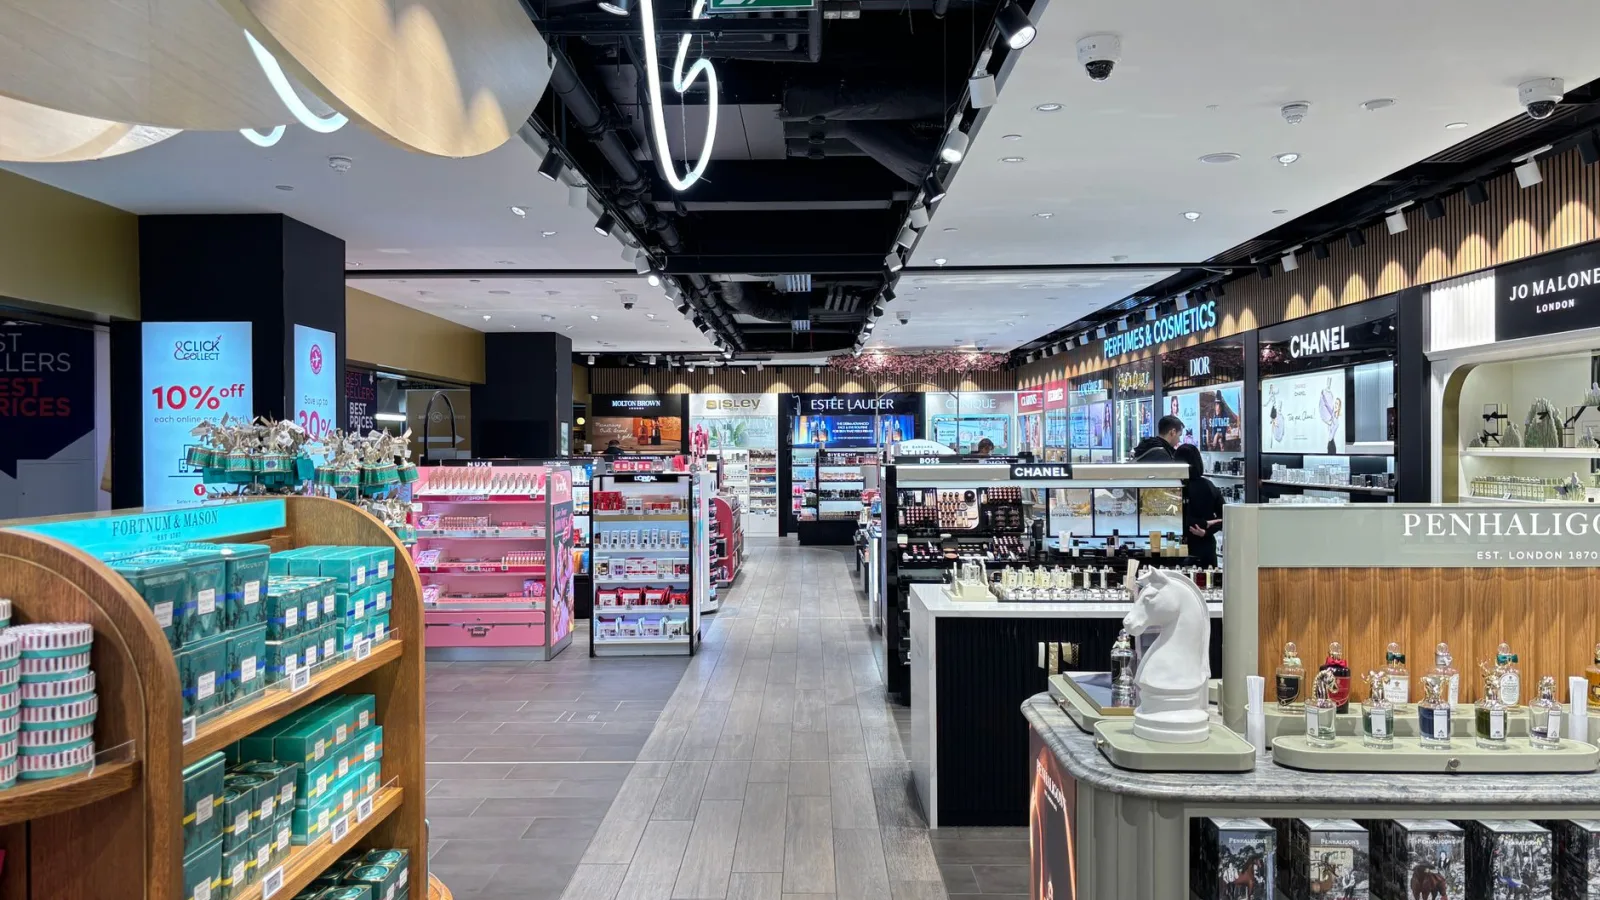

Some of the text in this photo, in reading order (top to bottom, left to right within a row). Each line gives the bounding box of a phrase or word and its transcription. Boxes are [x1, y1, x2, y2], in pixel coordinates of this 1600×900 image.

[1509, 267, 1600, 301] JO MALONE
[1536, 299, 1575, 313] LONDON
[1103, 300, 1216, 358] PERFUMES & COSMETICS
[183, 340, 220, 352] CLICK
[1290, 325, 1350, 358] CHANEL
[0, 353, 71, 372] LERS
[184, 352, 220, 361] COLLECT
[1190, 356, 1210, 377] DIOR
[152, 383, 245, 410] 10% off
[349, 401, 368, 416] BEST
[612, 400, 661, 408] MOLTON BROWN
[847, 399, 894, 410] LAUDER
[945, 398, 997, 410] CLNIQUE
[154, 415, 175, 423] each
[179, 415, 200, 423] online
[349, 415, 374, 430] PRICES
[1014, 467, 1069, 477] CHANEL
[112, 509, 219, 537] FORTNUM & MASON
[1477, 551, 1598, 560] EST. LONDON 1870
